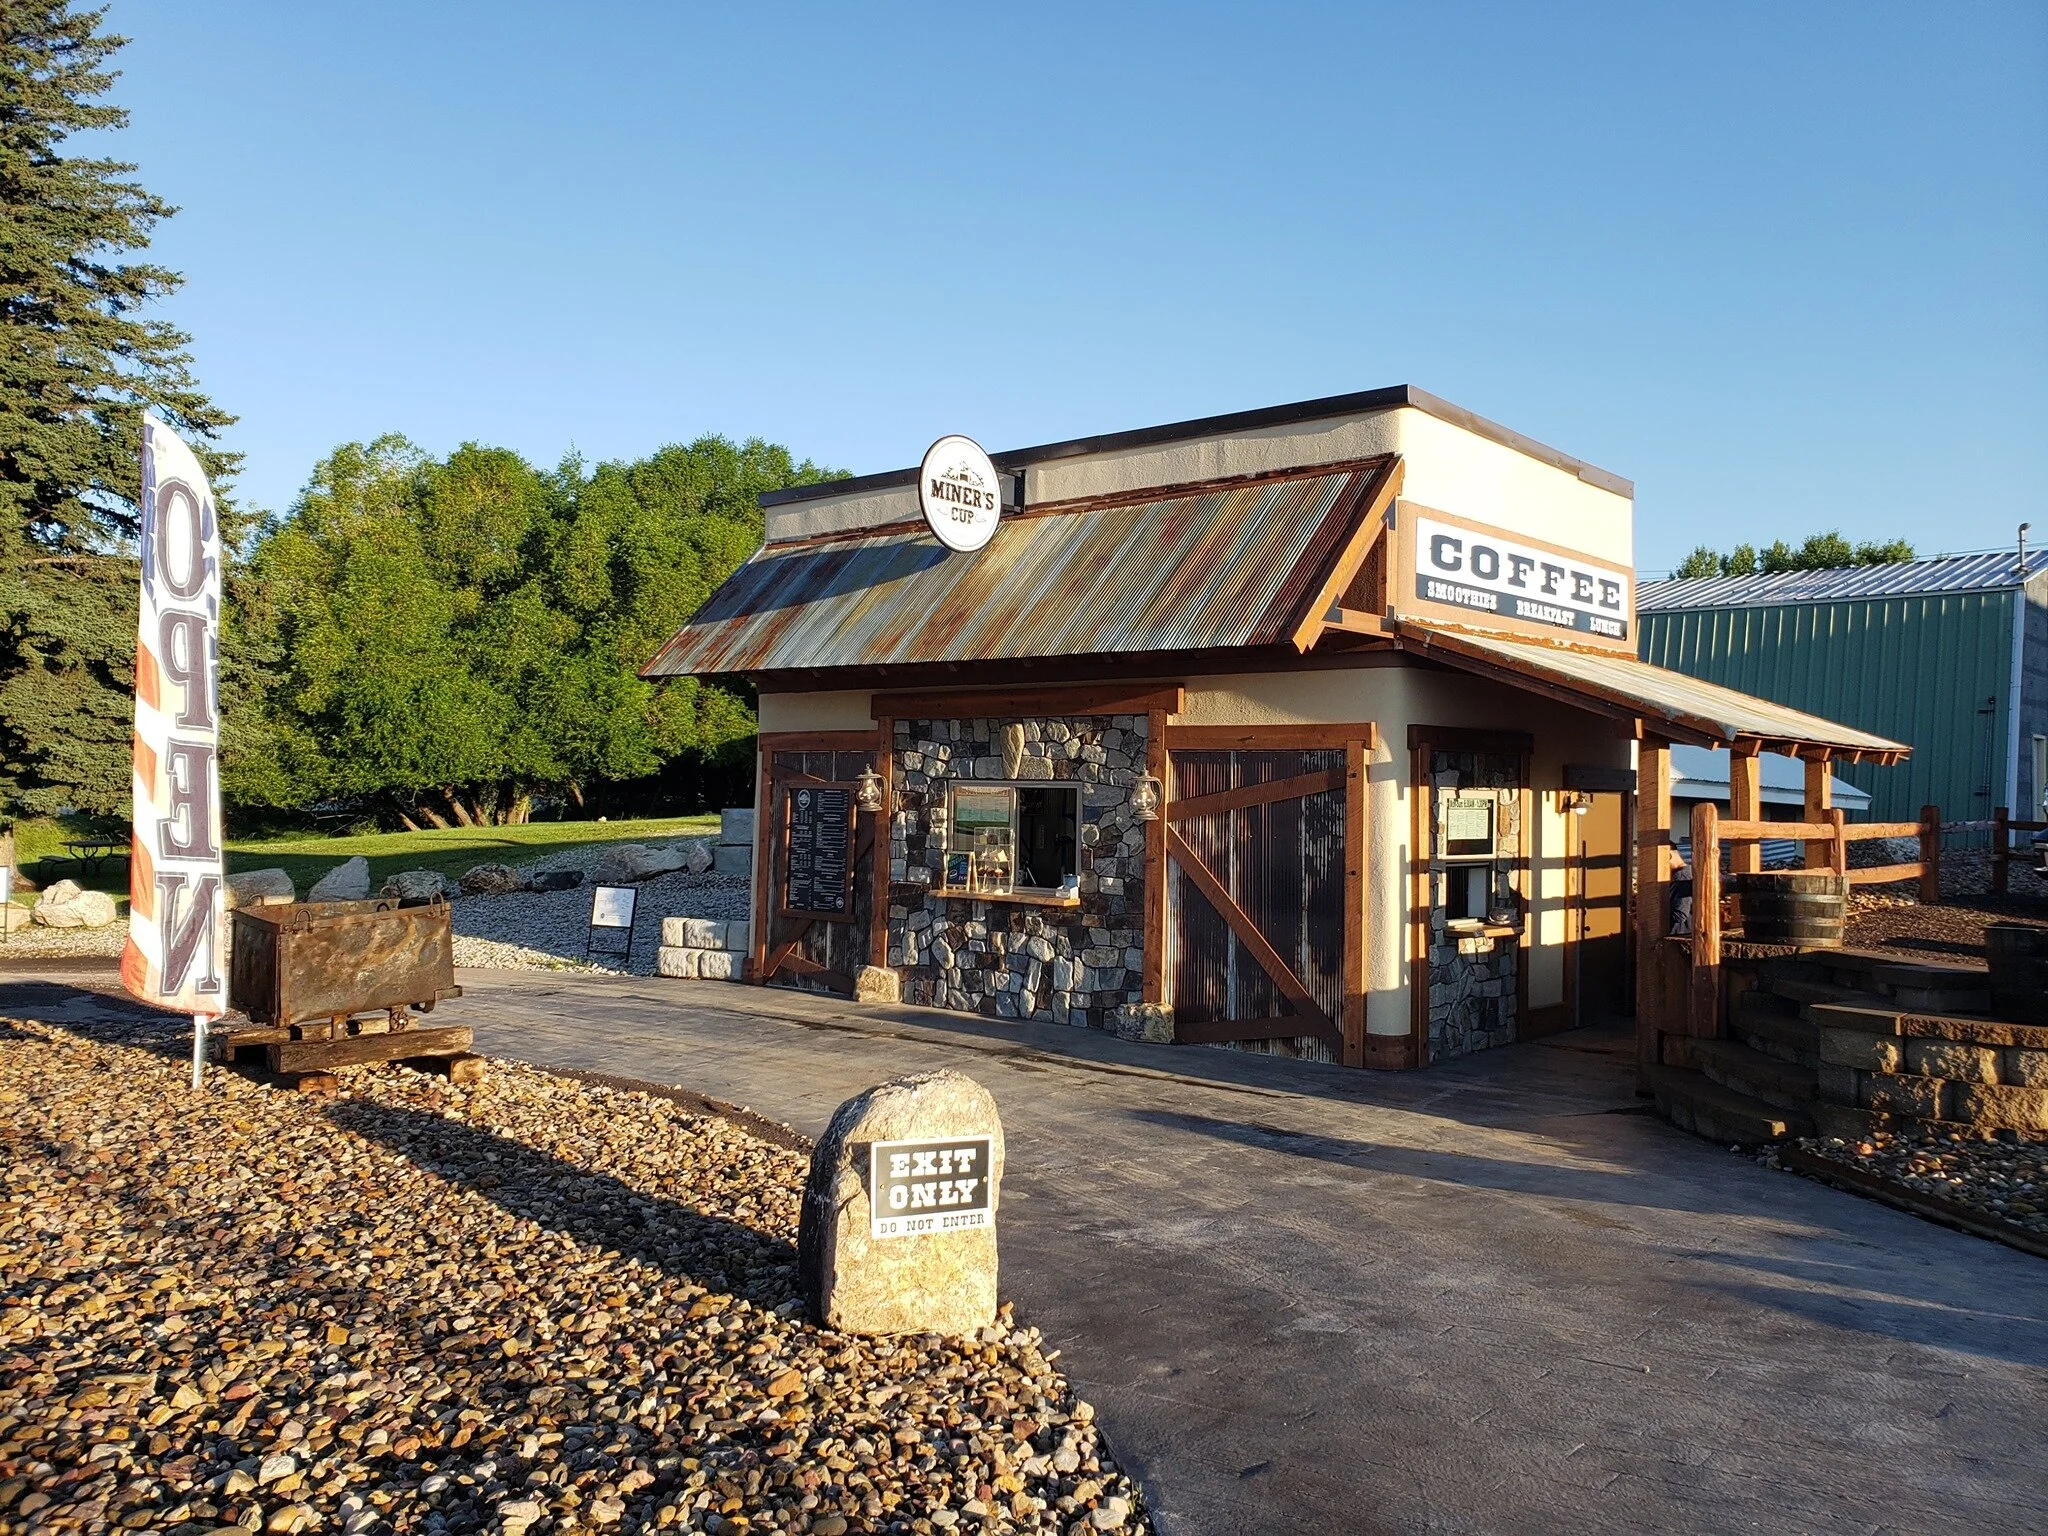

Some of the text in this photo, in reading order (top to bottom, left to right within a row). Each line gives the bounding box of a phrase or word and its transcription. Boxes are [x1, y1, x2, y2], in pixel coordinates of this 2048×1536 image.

[930, 478, 995, 511] MINER'S
[951, 507, 975, 525] CUP
[1430, 534, 1620, 611] COFFEE
[1427, 581, 1621, 637] SMOOTHIES BREAKFAST LUNCH
[889, 1148, 977, 1178] EXIT
[888, 1178, 979, 1210] ONLY
[880, 1213, 985, 1234] DO NOT ENTER
